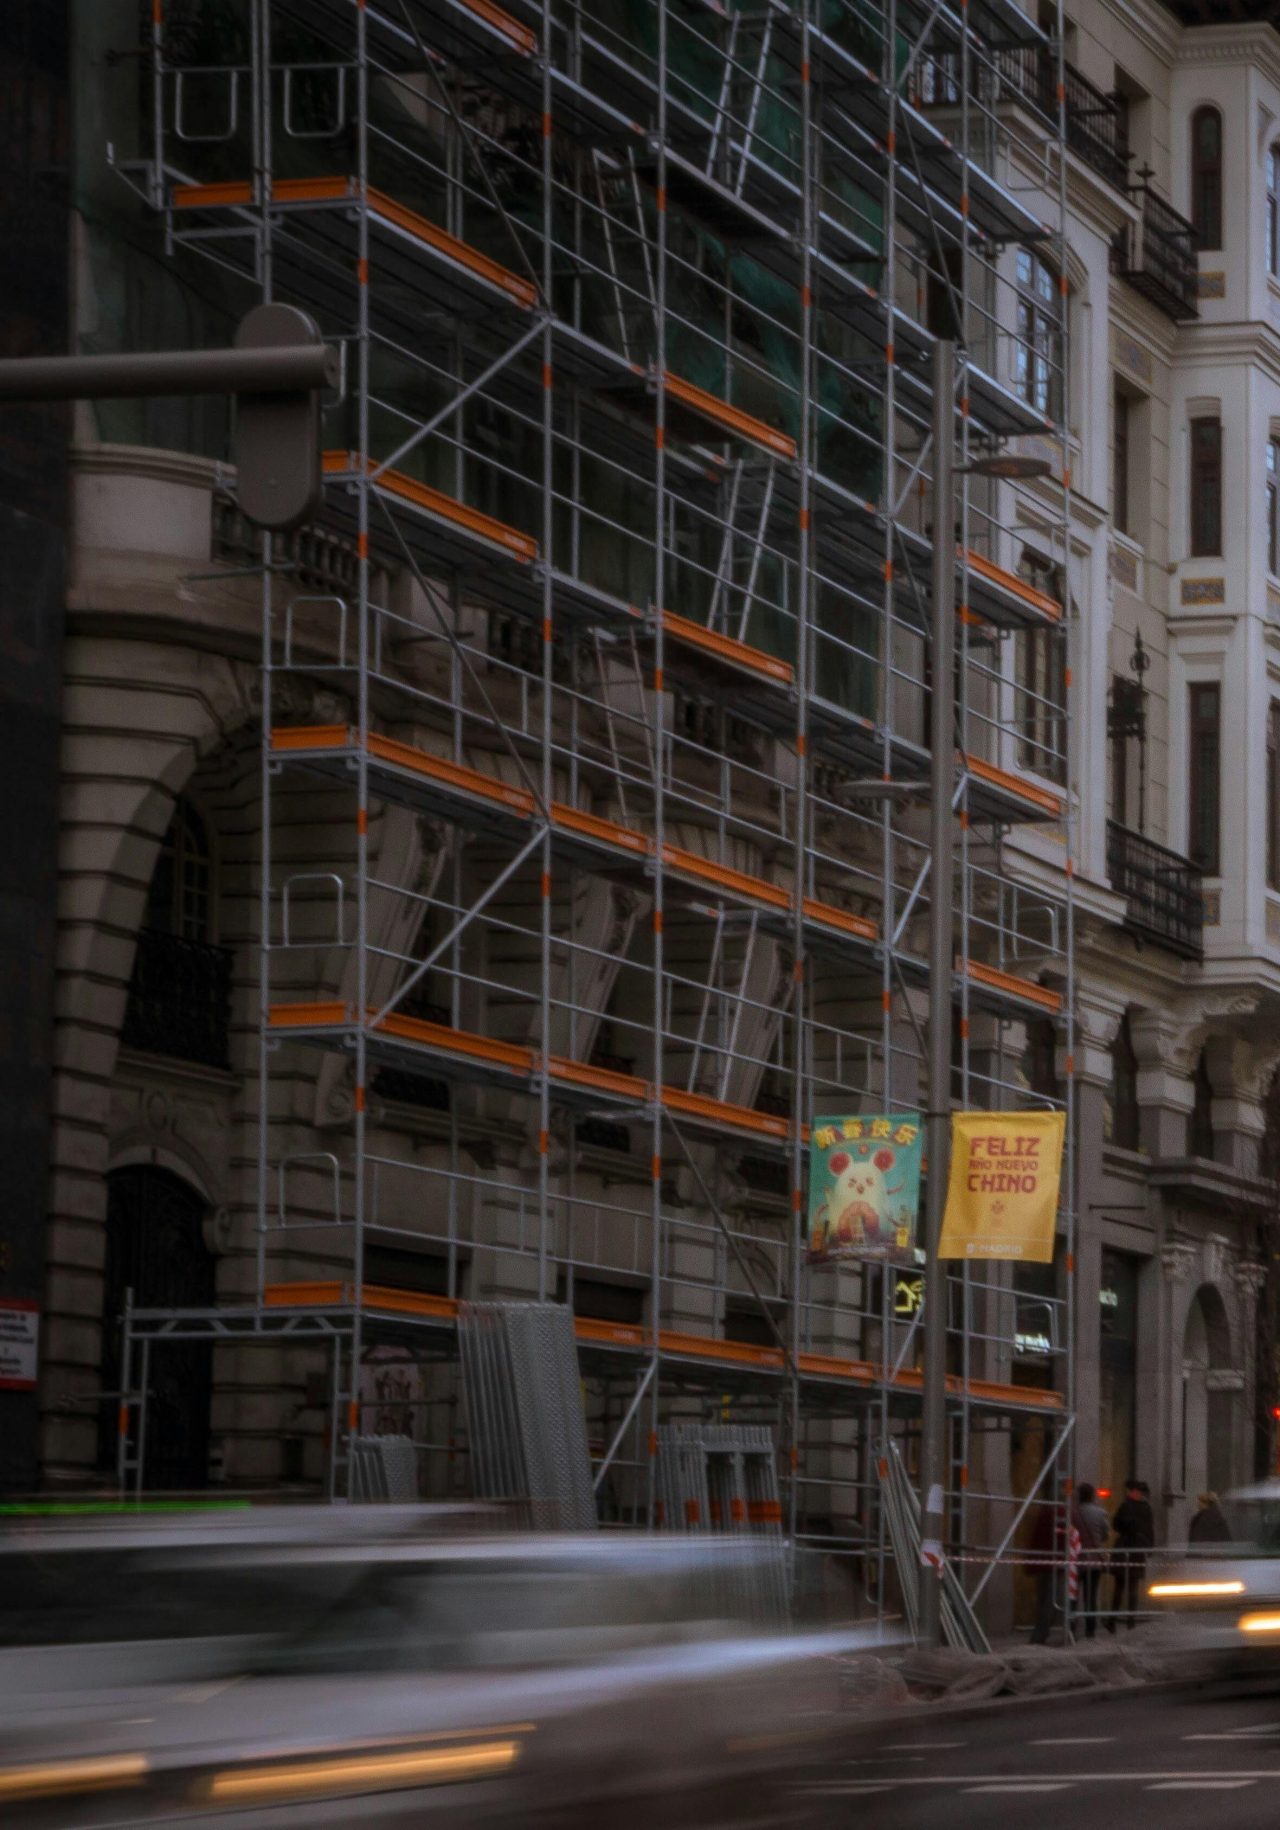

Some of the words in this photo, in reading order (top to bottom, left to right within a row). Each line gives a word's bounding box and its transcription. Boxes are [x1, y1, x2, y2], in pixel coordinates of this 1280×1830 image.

[970, 1136, 1041, 1156] FELIZ
[996, 1160, 1039, 1172] NUEVO
[967, 1173, 1037, 1193] CHINO
